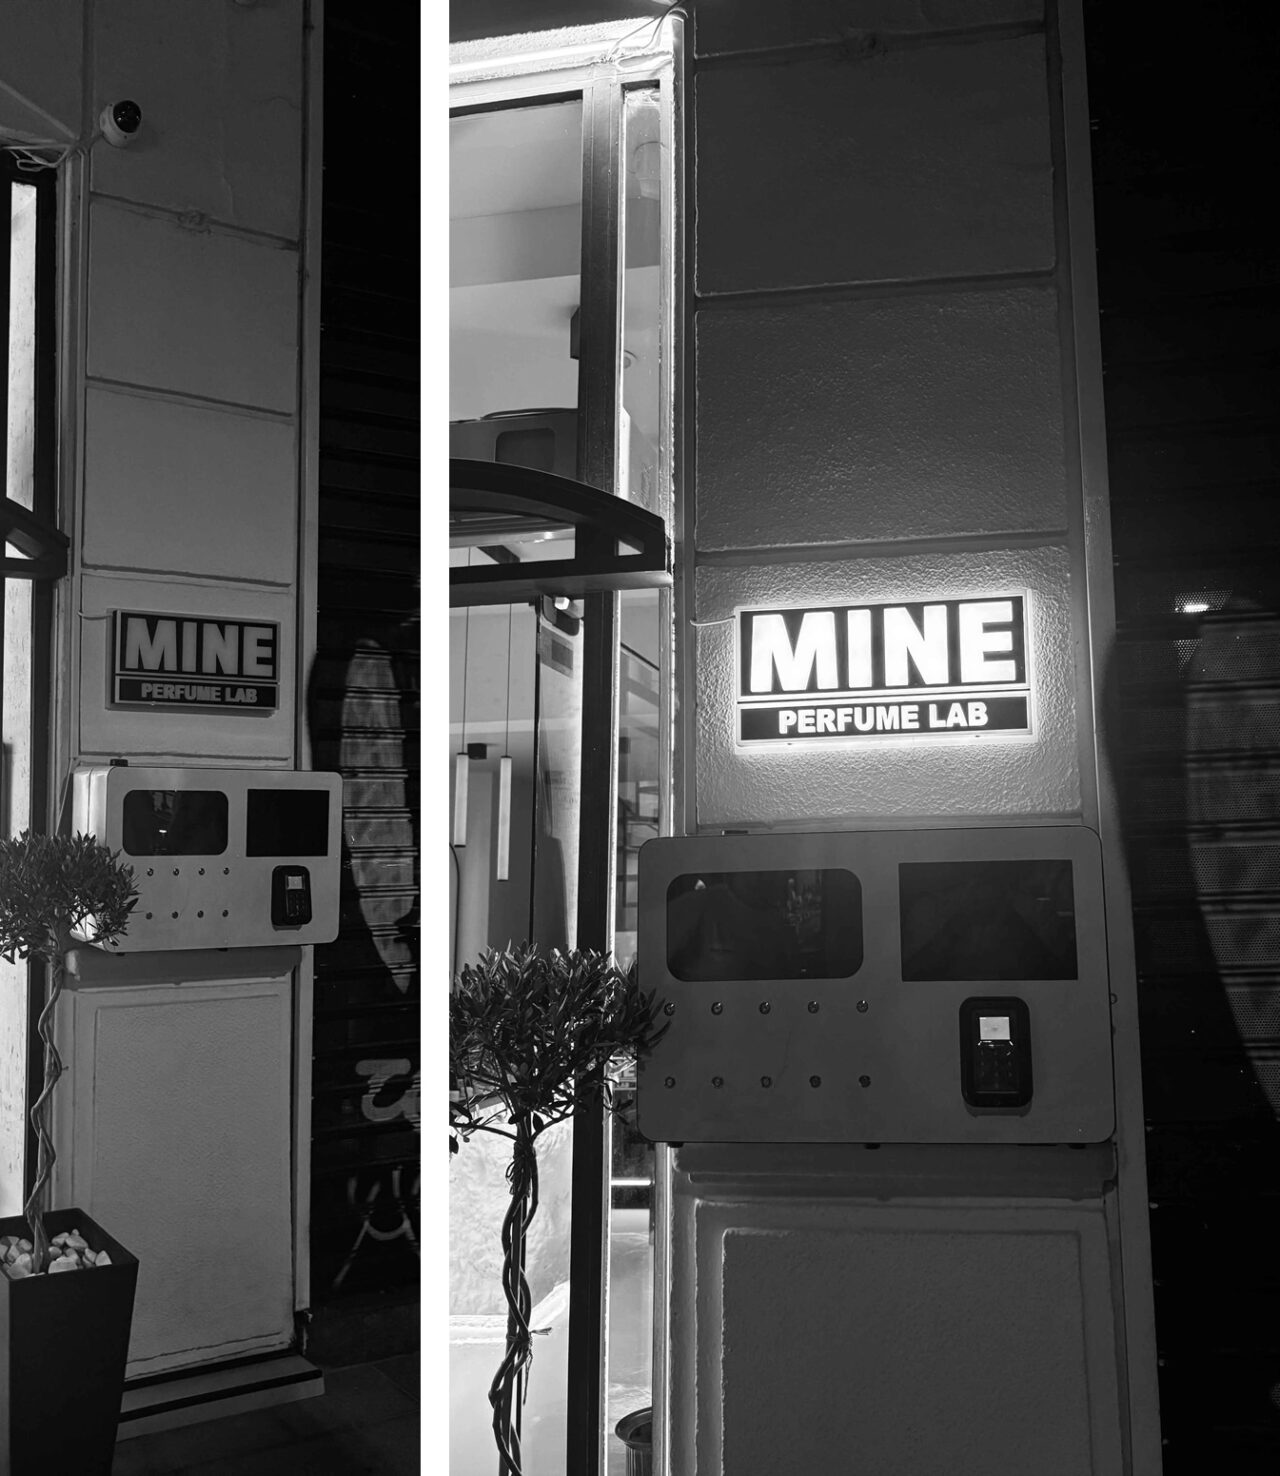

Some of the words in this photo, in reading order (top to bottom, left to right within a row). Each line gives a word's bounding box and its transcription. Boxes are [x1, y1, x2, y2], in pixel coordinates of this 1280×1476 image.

[125, 617, 274, 677] MINE
[750, 600, 1018, 693] MINE
[141, 682, 221, 703] PERFUME
[225, 687, 258, 704] LAB
[778, 705, 920, 735] PERFUME
[928, 701, 989, 729] LAB
